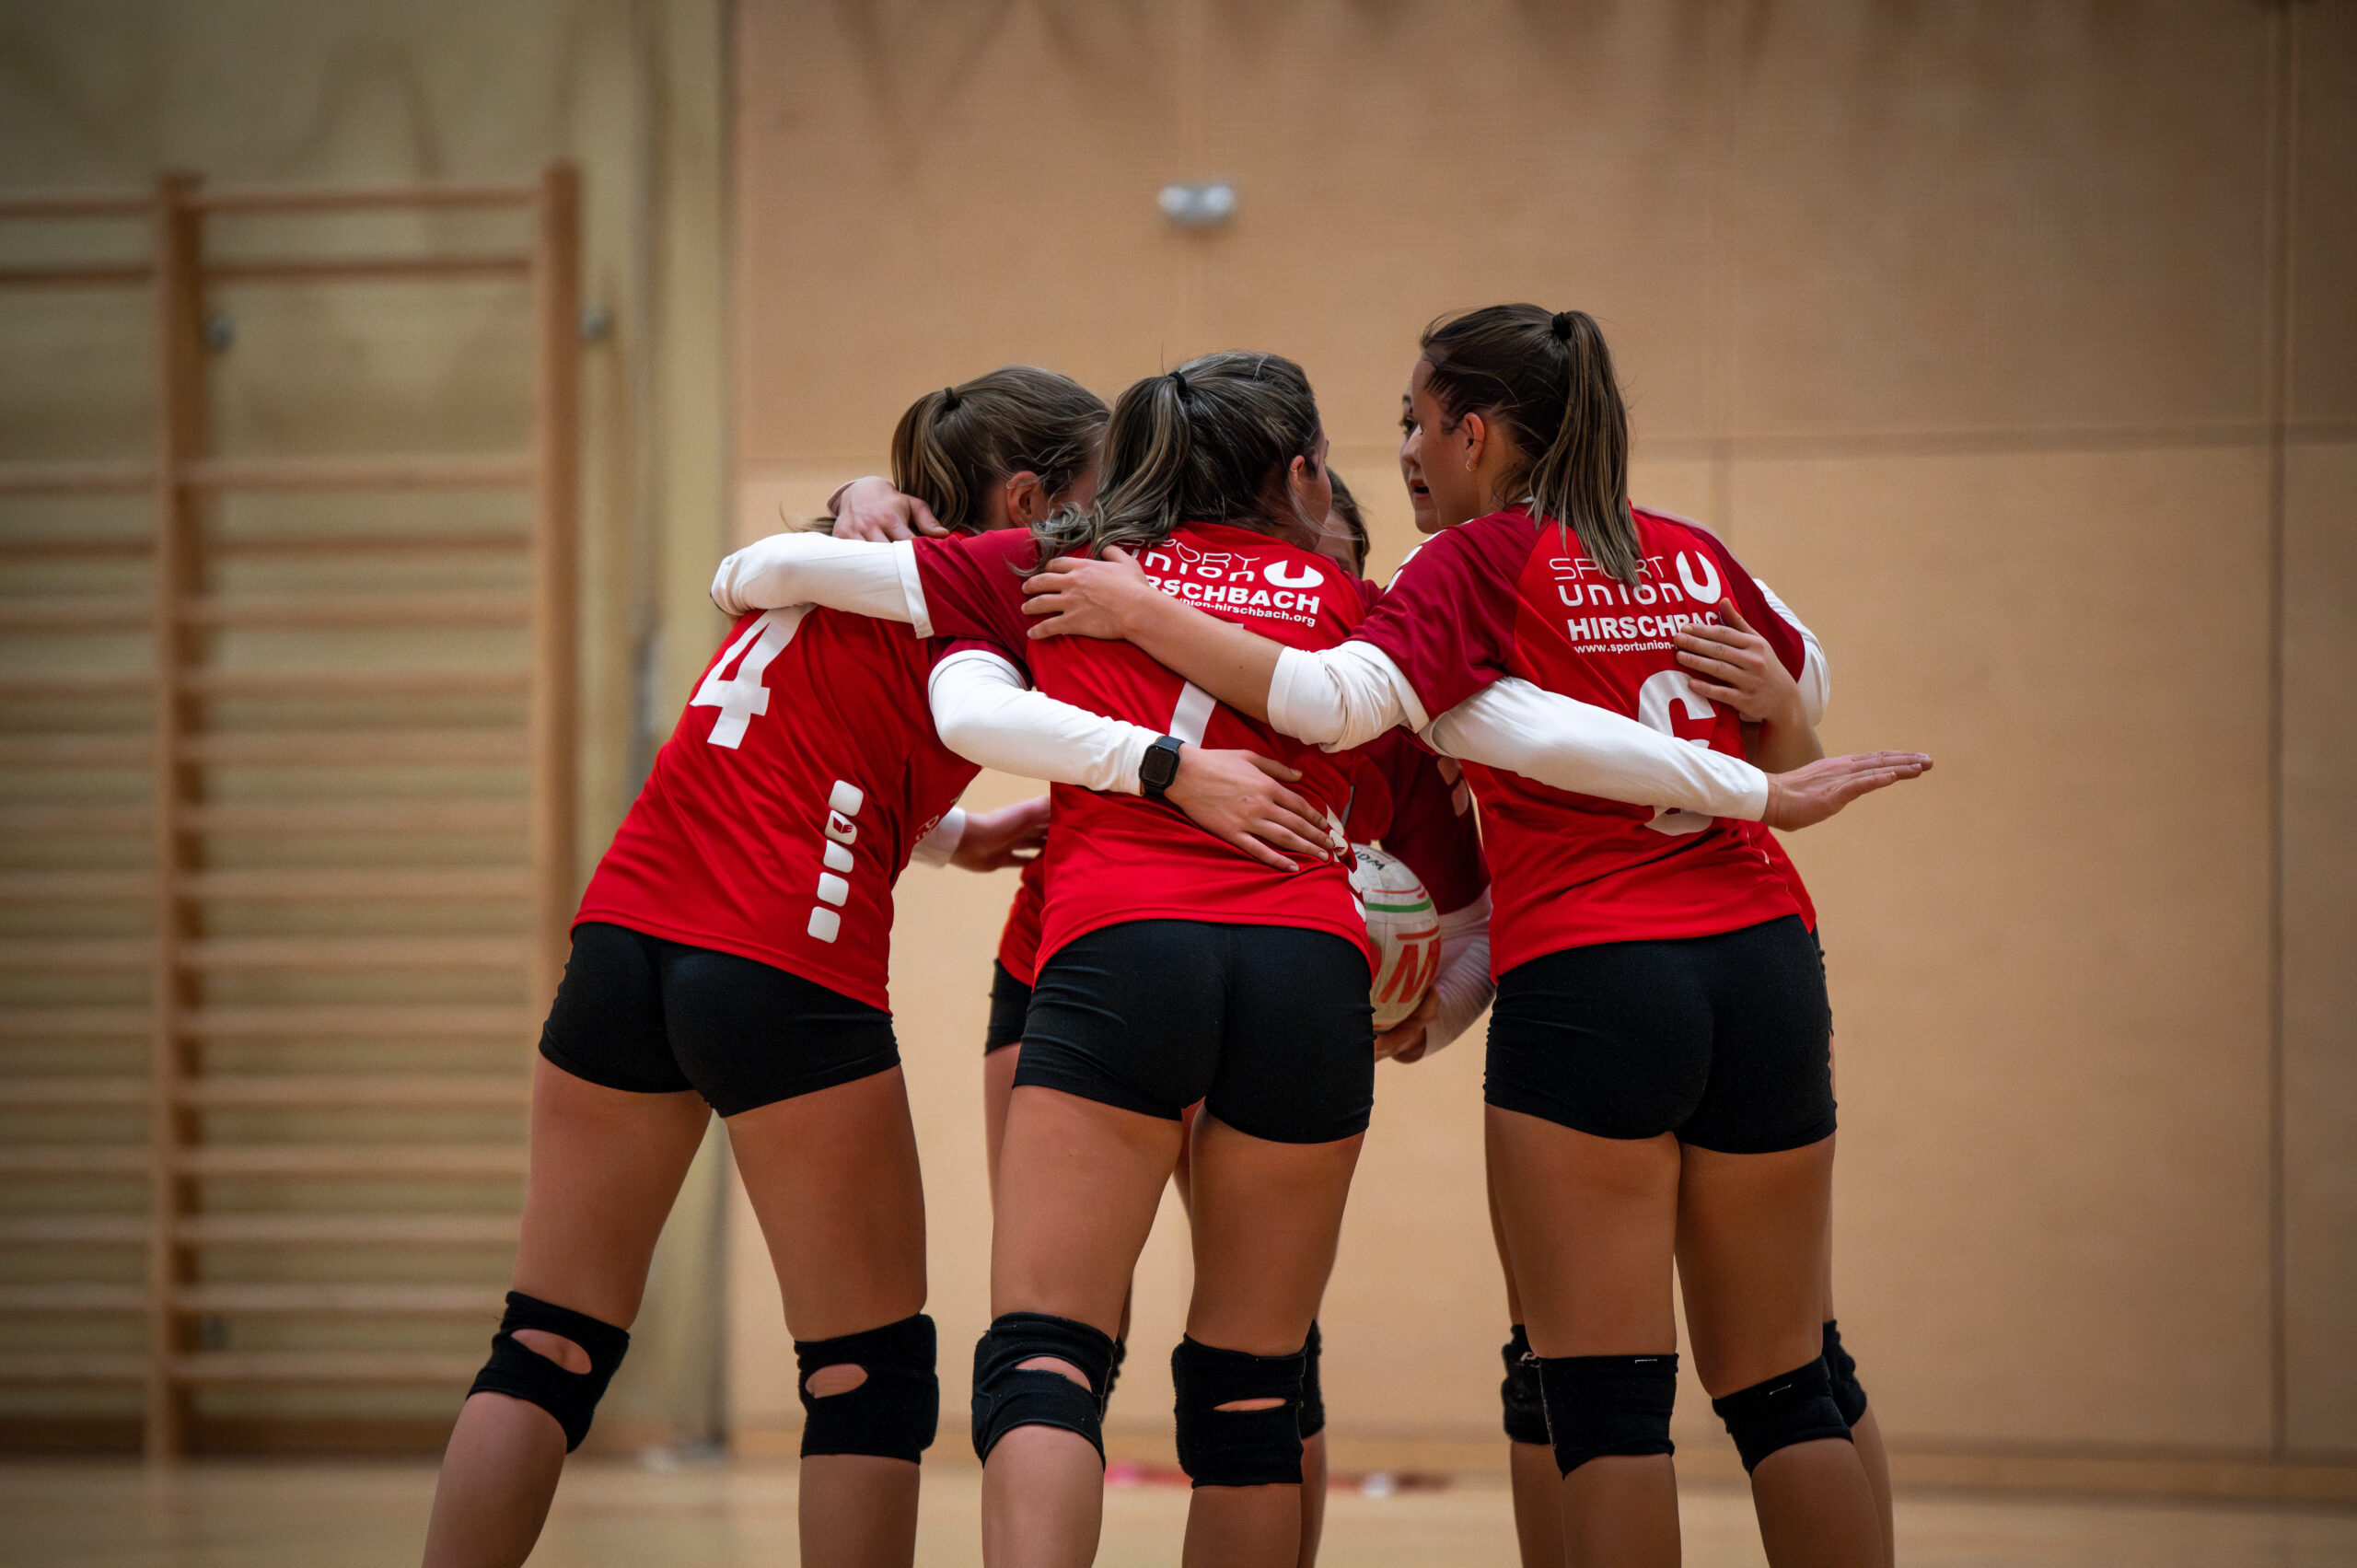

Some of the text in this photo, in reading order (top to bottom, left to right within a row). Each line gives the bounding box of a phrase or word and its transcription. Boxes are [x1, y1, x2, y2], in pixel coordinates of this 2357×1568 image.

[1131, 549, 1256, 583] nion
[1147, 575, 1321, 615] RSCHBACH
[1558, 582, 1684, 607] union
[1567, 610, 1724, 642] HIRSCHBAC
[689, 603, 818, 750] 4
